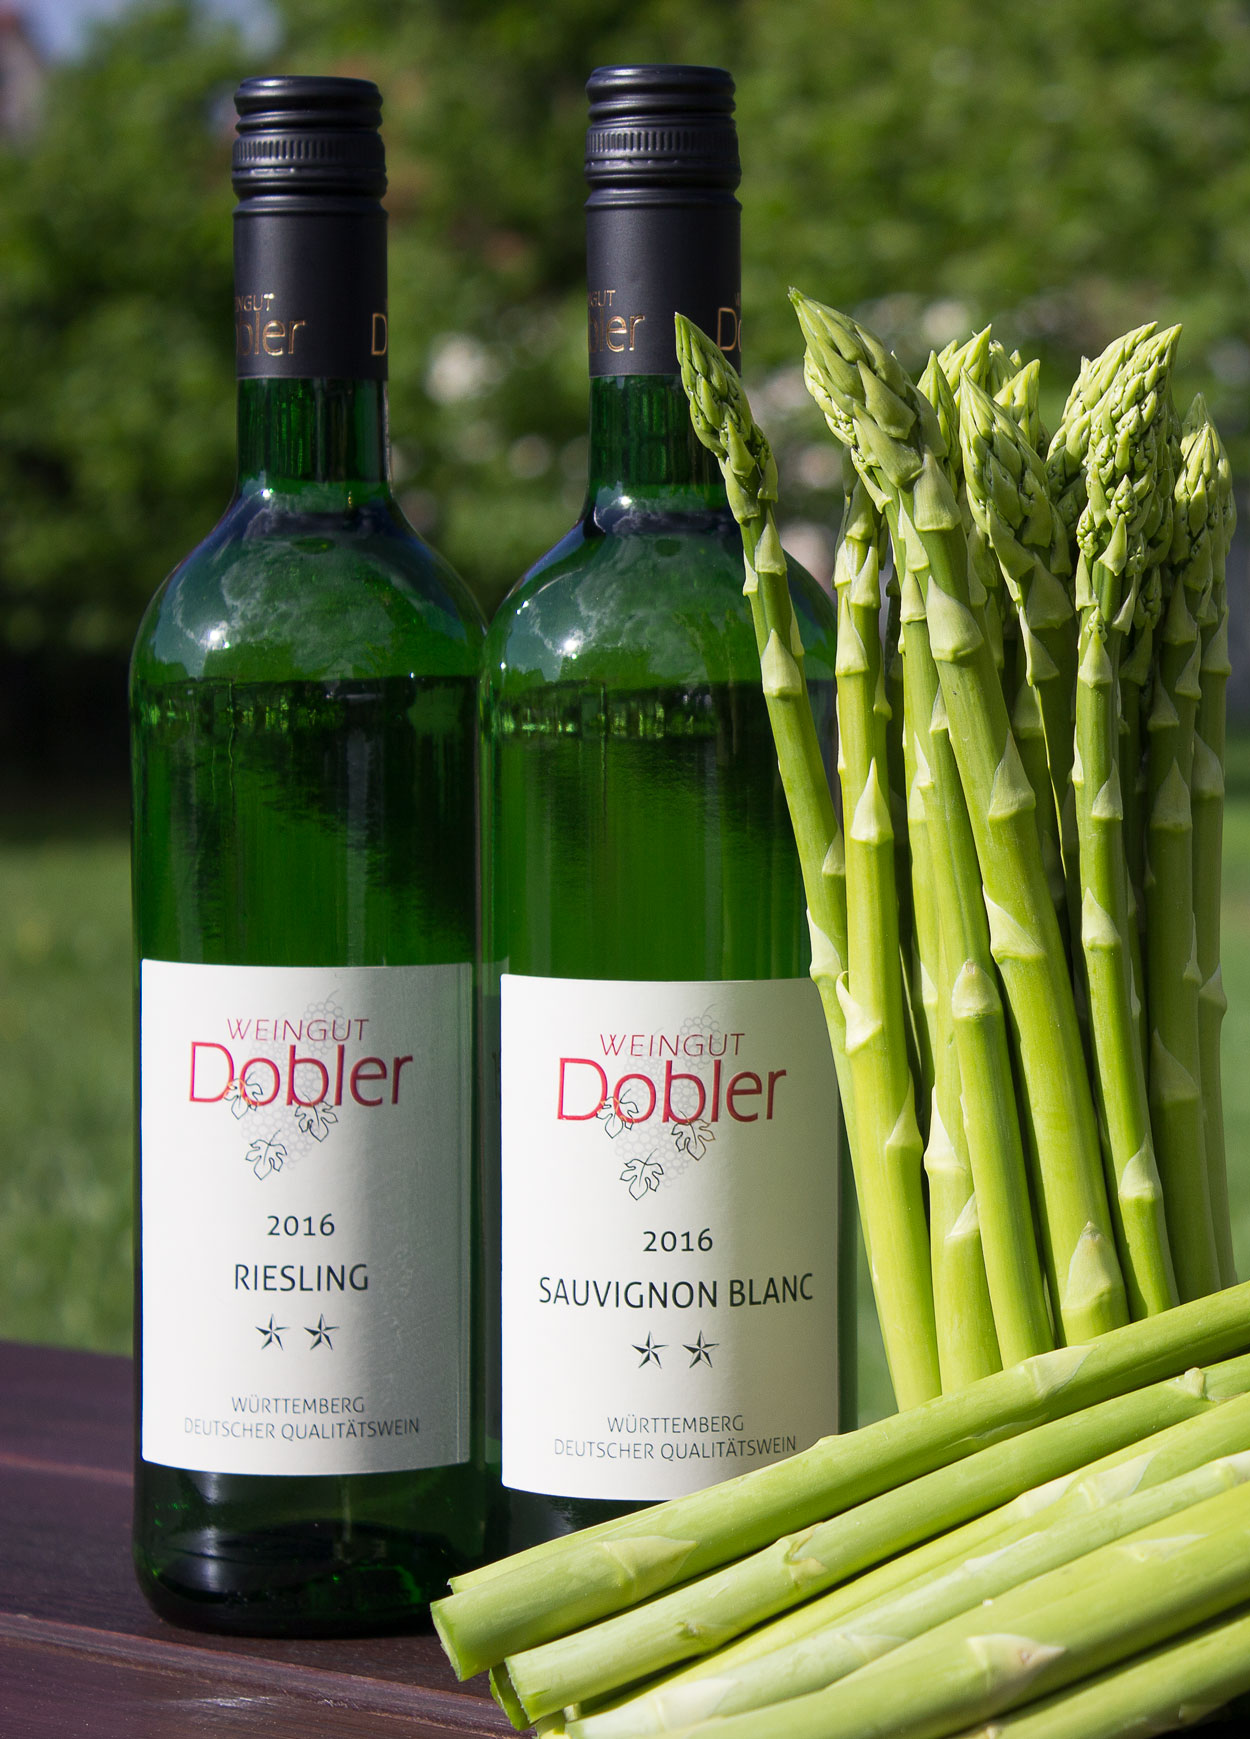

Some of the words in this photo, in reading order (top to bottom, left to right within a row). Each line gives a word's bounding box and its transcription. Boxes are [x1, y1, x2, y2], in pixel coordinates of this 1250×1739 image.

[235, 293, 275, 312] NGUT
[236, 311, 306, 356] bler
[227, 1018, 369, 1042] WEINGUT
[600, 1033, 745, 1056] WEINGUT
[188, 1041, 413, 1107] Dobler
[556, 1057, 787, 1123] Dobler
[267, 1213, 336, 1237] 2016
[643, 1228, 713, 1252] 2016
[233, 1264, 369, 1291] RIESLING
[538, 1276, 718, 1309] SAUVIGNON
[729, 1273, 813, 1307] BLANC
[231, 1394, 365, 1415] WÜRTTEMBERG
[184, 1417, 275, 1441] DEUTSCHER
[281, 1416, 420, 1441] QUALITÄTSWEIN
[607, 1411, 744, 1434] WÜRTTEMBERG
[554, 1438, 654, 1460] DEUTSCHER
[660, 1435, 797, 1462] QUALITÄTSWEIN
